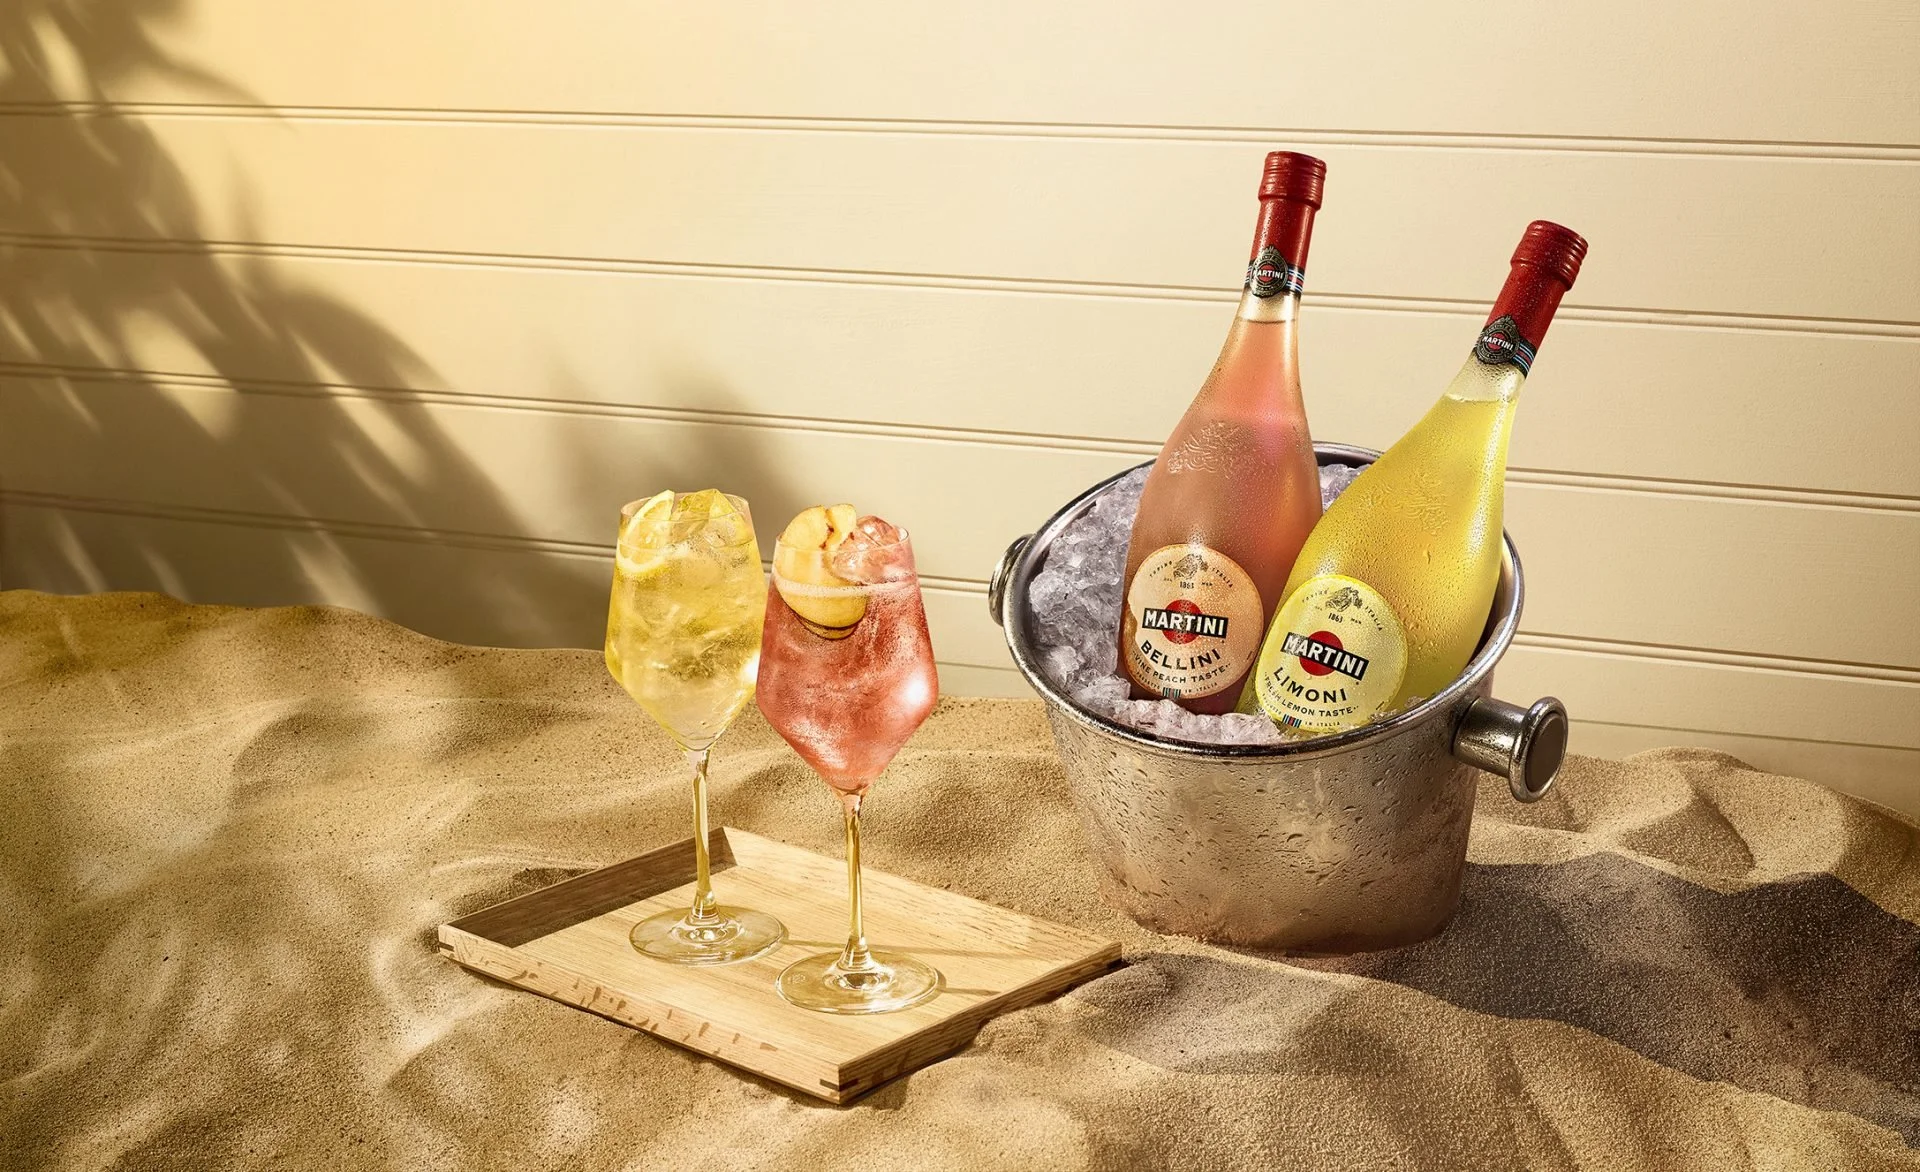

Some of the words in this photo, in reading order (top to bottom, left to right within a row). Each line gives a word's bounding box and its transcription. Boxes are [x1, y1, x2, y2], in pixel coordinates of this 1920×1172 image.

[1482, 336, 1514, 350] MARTINI
[1212, 567, 1233, 588] ITALIA
[1144, 611, 1225, 636] MARTINI
[1328, 612, 1343, 623] 1863
[1364, 606, 1383, 631] ITALIA
[1140, 640, 1221, 670] BELLINI
[1284, 635, 1365, 676] MARTINI
[1135, 654, 1150, 674] VINE
[1153, 671, 1186, 683] PEACH
[1191, 666, 1226, 683] TASTE
[1196, 683, 1217, 692] ITALIA
[1265, 675, 1281, 701] FRESH
[1281, 698, 1315, 716] LEMON
[1319, 706, 1352, 717] TASTE
[1273, 667, 1347, 703] LIMONI
